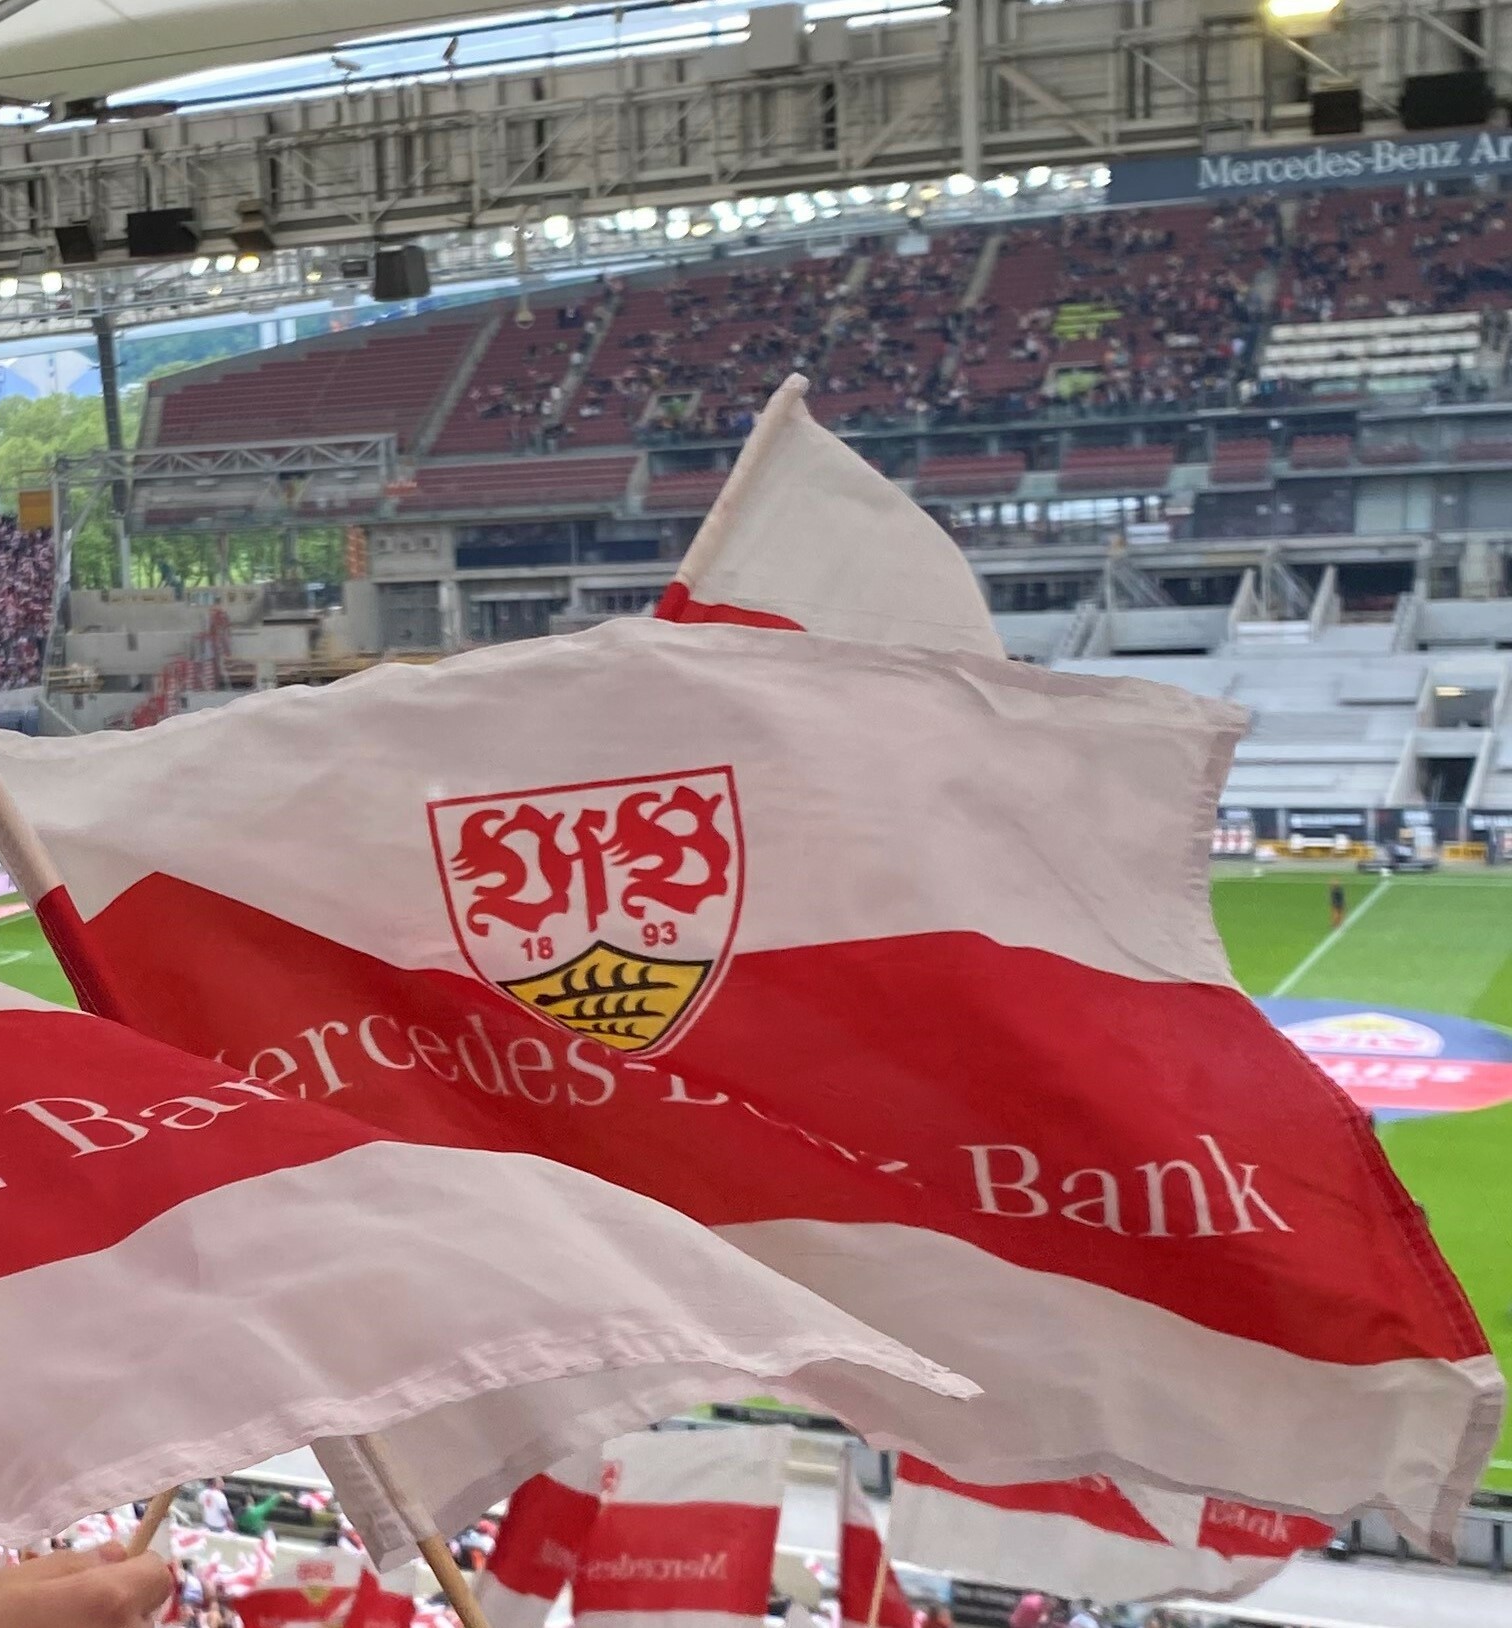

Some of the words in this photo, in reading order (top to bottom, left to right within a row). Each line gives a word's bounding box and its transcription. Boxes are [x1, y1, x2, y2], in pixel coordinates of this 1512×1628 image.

[1197, 139, 1462, 190] Mercedes-Benz
[520, 936, 554, 961] 18
[641, 921, 677, 946] 93
[959, 1133, 1296, 1239] Bank
